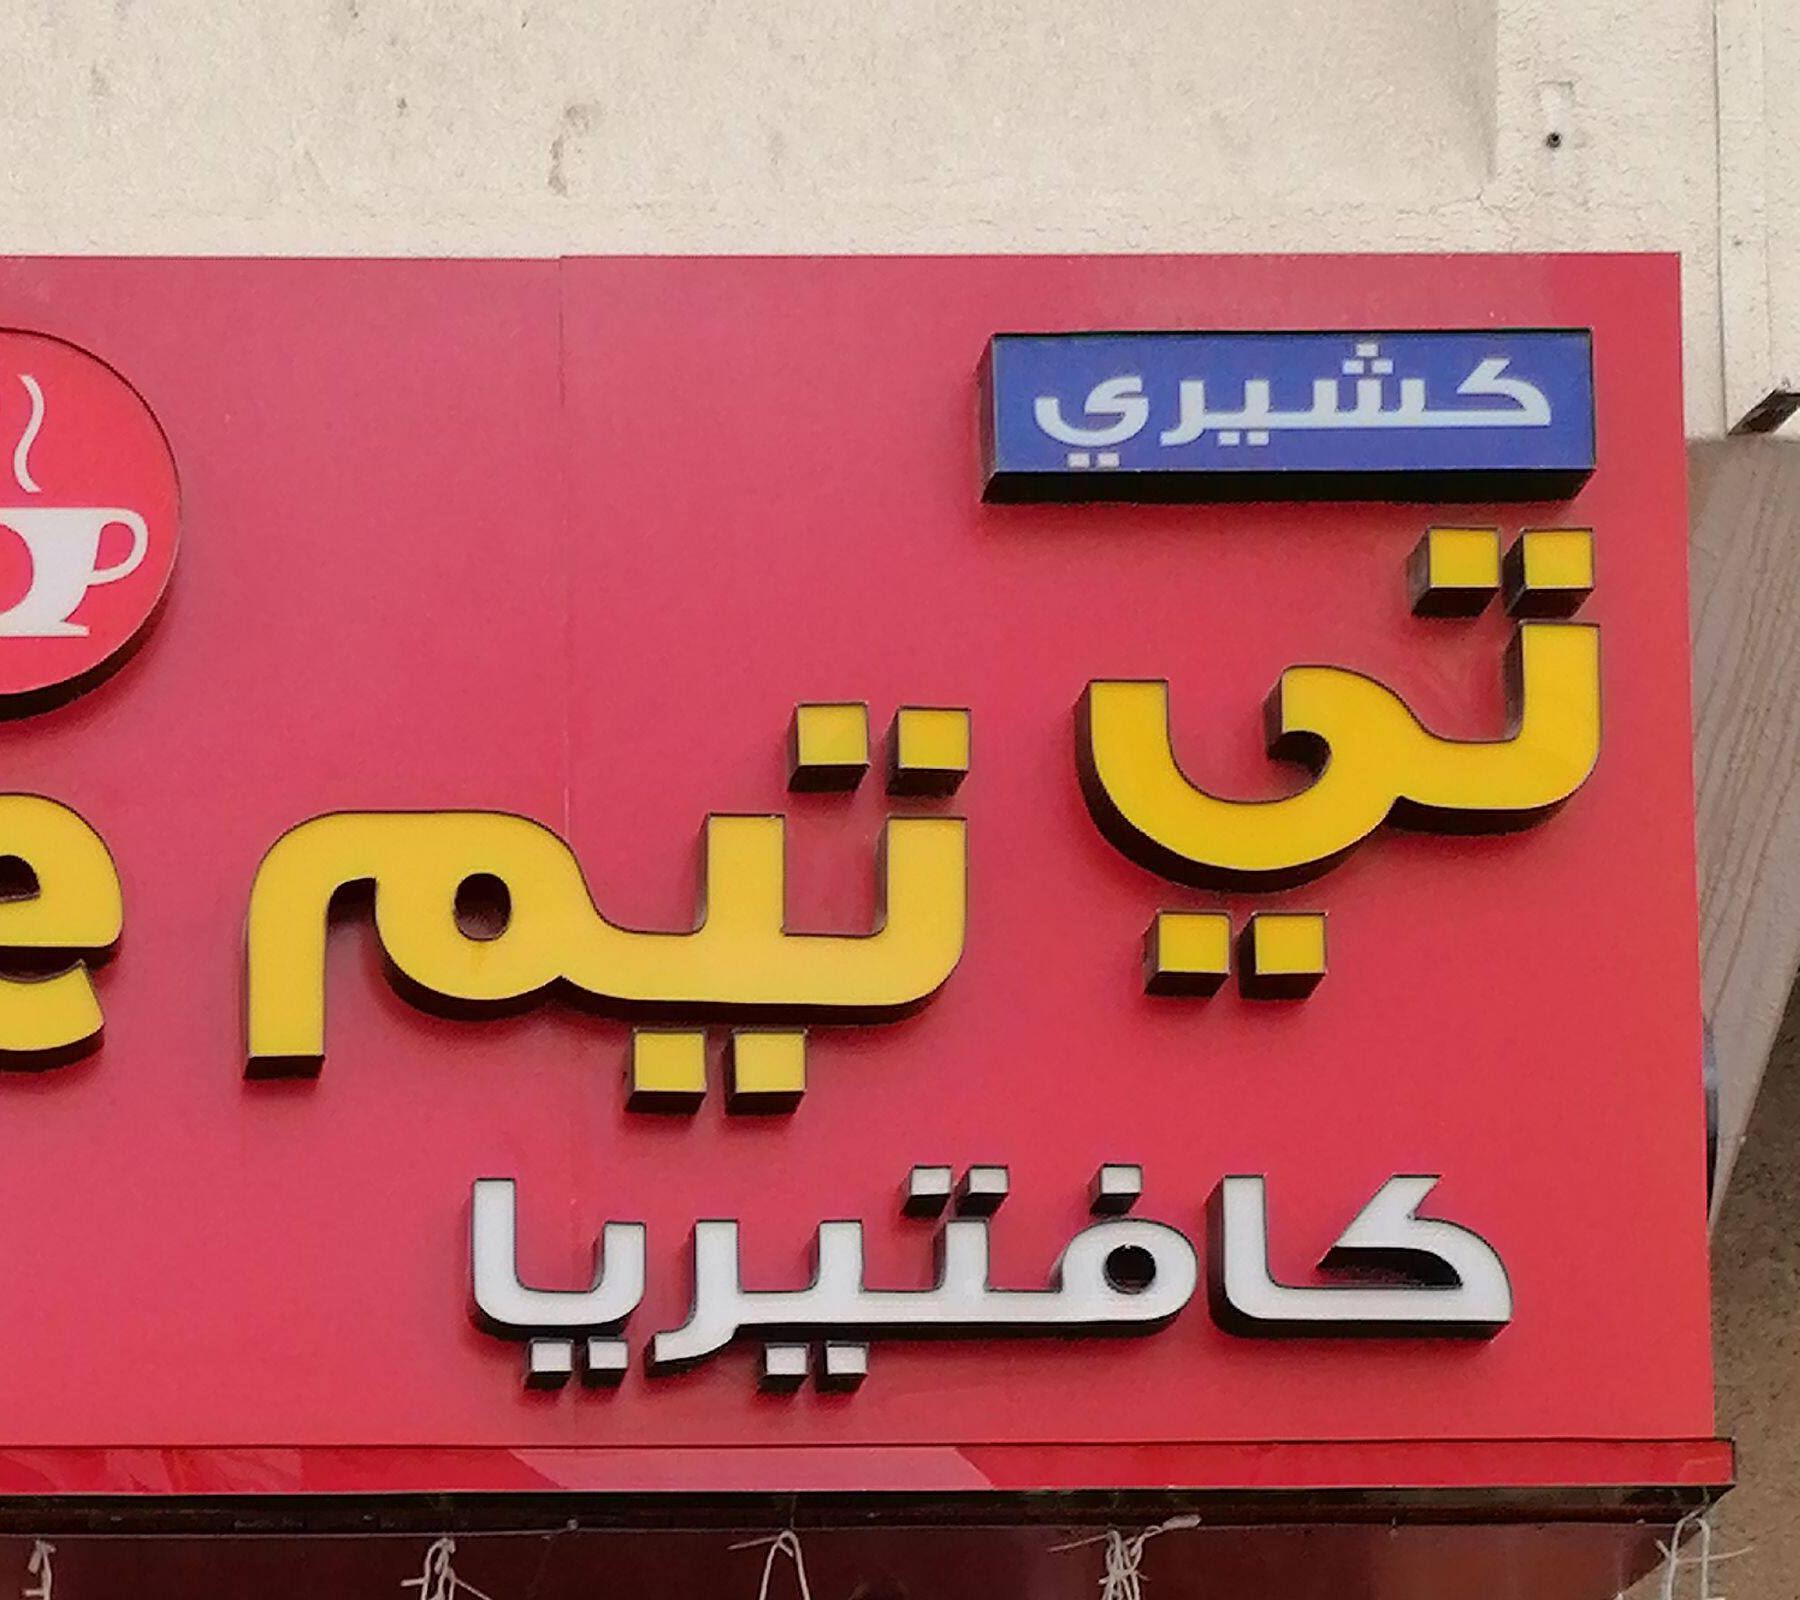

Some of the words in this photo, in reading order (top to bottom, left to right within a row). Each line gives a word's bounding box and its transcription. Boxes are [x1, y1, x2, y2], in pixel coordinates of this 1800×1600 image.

[1035, 342, 1553, 468] كشيري
[246, 702, 972, 1105] تيم
[1082, 527, 1602, 988] تي
[470, 1165, 1514, 1390] كافتيريا
